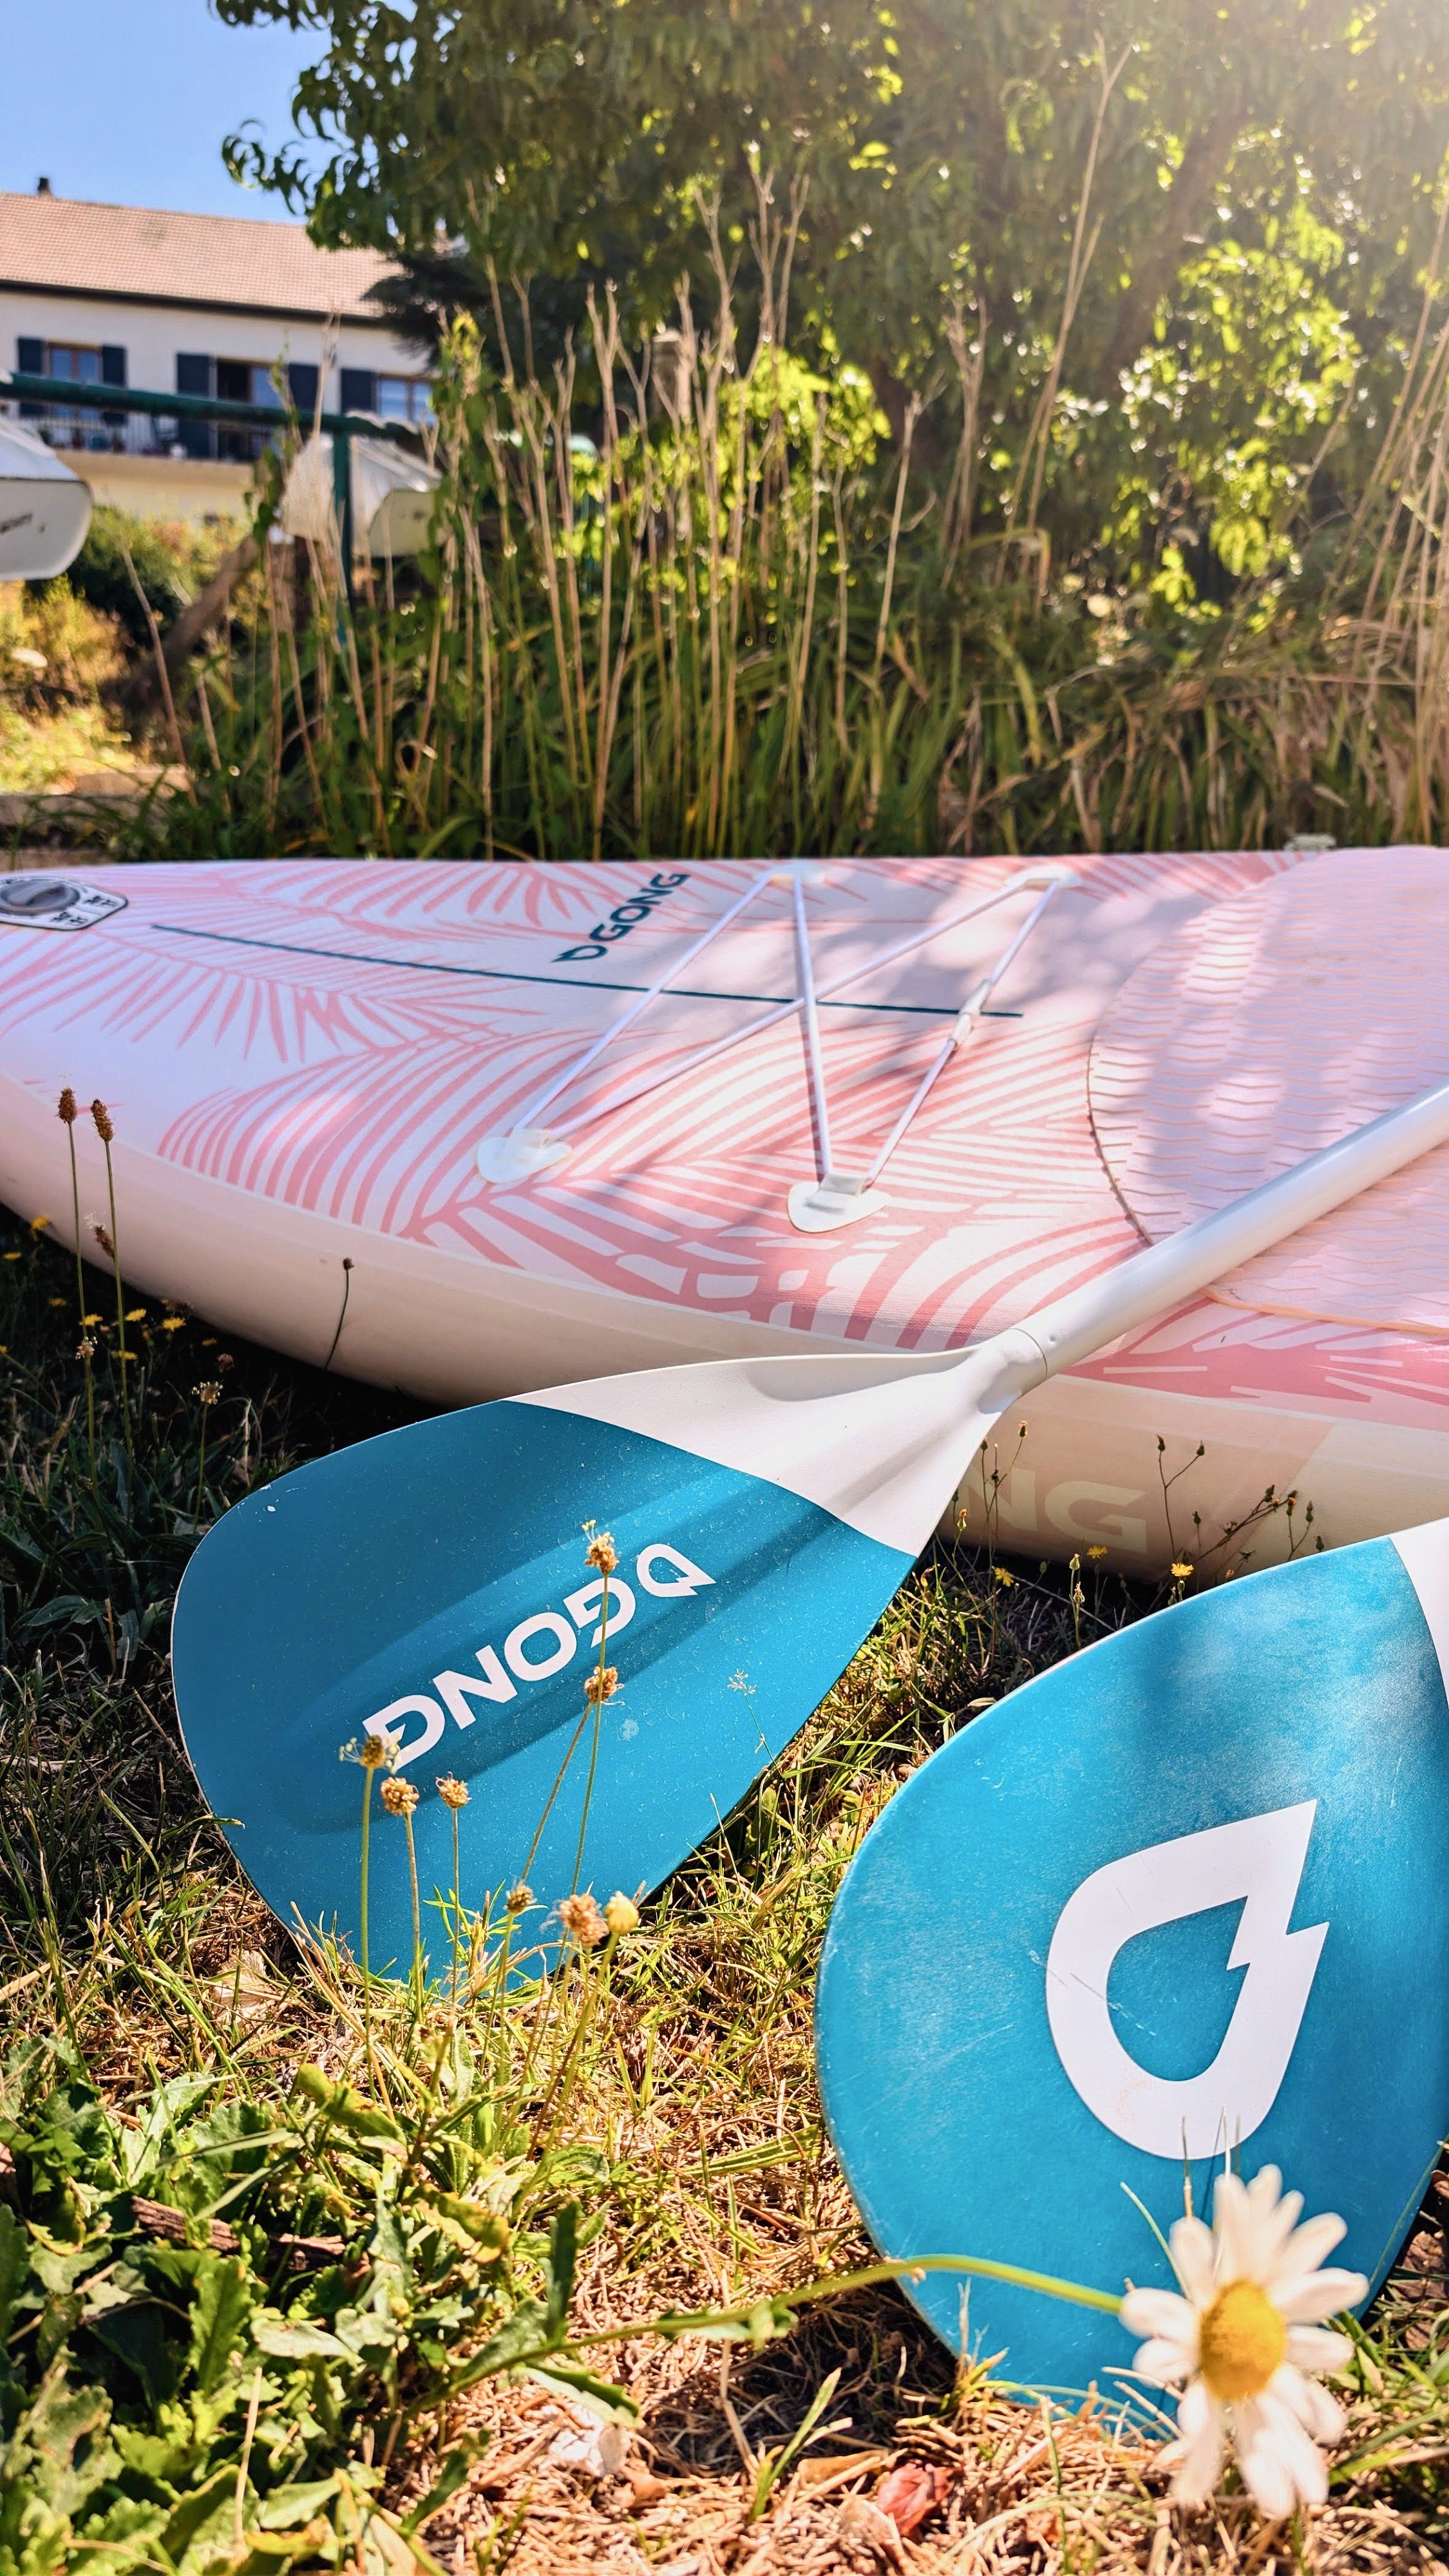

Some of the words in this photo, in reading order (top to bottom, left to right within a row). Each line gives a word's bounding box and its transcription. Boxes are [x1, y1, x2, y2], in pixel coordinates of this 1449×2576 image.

[589, 874, 691, 942] GONG
[953, 1464, 1146, 1553] NG
[362, 1577, 636, 1772] GONG
